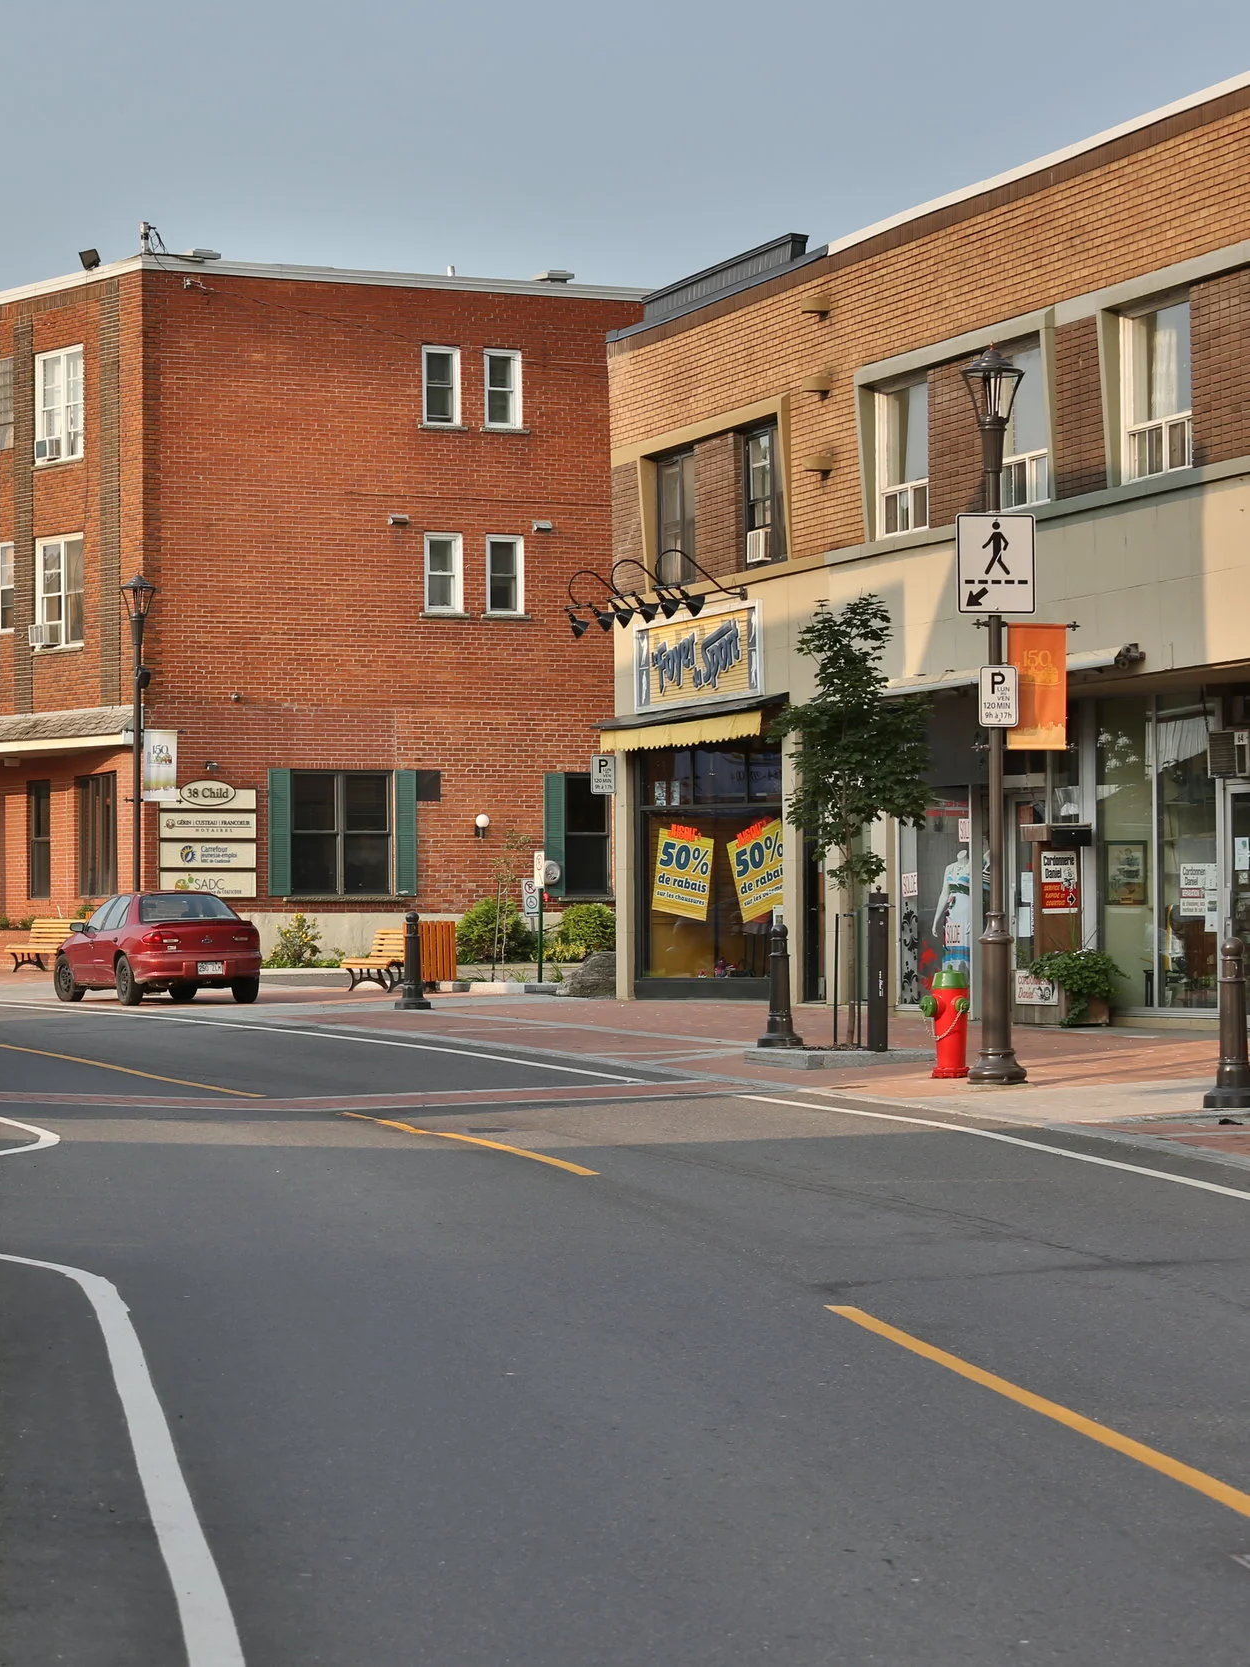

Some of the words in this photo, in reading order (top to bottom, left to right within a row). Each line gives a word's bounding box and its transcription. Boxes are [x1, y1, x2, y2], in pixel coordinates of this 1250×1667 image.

[657, 632, 698, 695] Foyer
[701, 618, 742, 691] Sport
[1023, 650, 1052, 667] 150
[991, 672, 1005, 694] P
[985, 711, 994, 719] 9h
[1000, 711, 1013, 719] 17h
[152, 744, 169, 755] 150
[599, 759, 608, 773] P
[186, 788, 200, 799] 38
[201, 787, 229, 799] Child
[176, 818, 192, 826] GÉRIN
[200, 845, 228, 853] Carrefour
[735, 830, 783, 878] 50%
[659, 840, 710, 876] 50%
[1043, 855, 1075, 866] Cordonnerie
[1045, 868, 1062, 878] Daniel
[1182, 866, 1206, 876] Cordonner
[194, 878, 226, 891] SADC
[658, 872, 671, 885] de
[672, 877, 707, 893] rabais
[740, 881, 753, 895] de
[755, 864, 783, 888] rabai
[1184, 876, 1199, 886] Daniel
[674, 894, 705, 906] chaussures
[743, 898, 753, 907] sur
[753, 893, 762, 903] les
